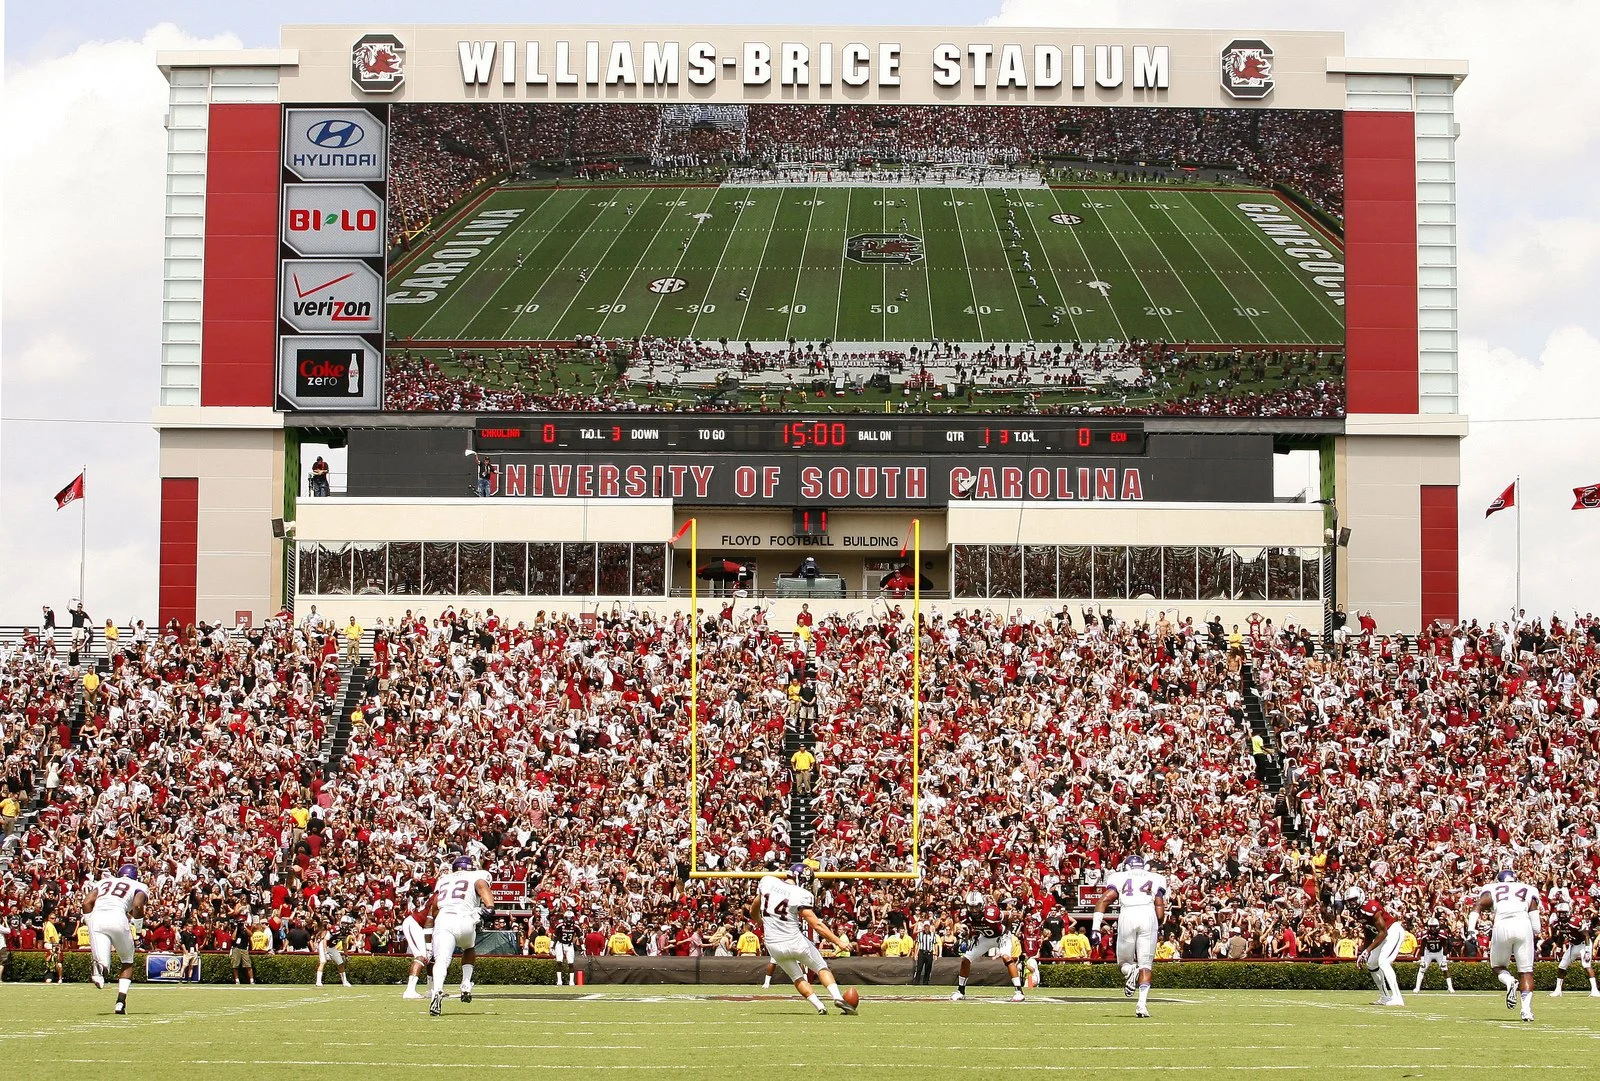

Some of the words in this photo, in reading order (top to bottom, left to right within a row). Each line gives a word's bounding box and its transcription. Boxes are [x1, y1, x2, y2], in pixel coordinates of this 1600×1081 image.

[457, 41, 902, 86] WILLIAMS-BRICE
[932, 43, 1171, 89] STADIUM
[293, 154, 377, 166] HYUNDAI
[1050, 214, 1082, 226] SEC
[386, 208, 526, 304] CAROLINA
[649, 277, 687, 294] SEC
[293, 296, 374, 321] verizon
[512, 303, 540, 313] 10
[596, 303, 627, 314] 20
[686, 303, 717, 314] 30
[777, 304, 807, 314] 40
[870, 304, 899, 314] 50
[963, 305, 992, 315] 40
[1054, 305, 1083, 316] 30
[1143, 306, 1174, 316] 20
[1232, 306, 1261, 317] 10
[299, 360, 345, 378] Coke
[307, 376, 338, 387] zero
[544, 424, 555, 443] 0
[611, 426, 621, 441] 3
[631, 429, 659, 440] DOWN
[698, 429, 711, 440] TO
[712, 429, 725, 441] GO
[783, 423, 846, 446] 15:00
[858, 431, 878, 441] BALL
[879, 431, 892, 441] ON
[946, 431, 965, 442] QTR
[984, 427, 991, 443] 1
[999, 429, 1009, 444] 3
[1078, 428, 1090, 447] 0
[1110, 432, 1128, 442] ECU
[482, 464, 715, 498] UNIVERSITY
[734, 465, 781, 499] OF
[801, 466, 928, 499] SOUTH
[949, 466, 1145, 500] CAROLINA
[803, 511, 827, 532] 11
[721, 535, 761, 546] FLOYD
[769, 536, 834, 547] FOOTBALL
[843, 536, 899, 547] BUILDING
[98, 881, 131, 899] 38
[439, 879, 469, 902] 52
[1121, 878, 1154, 897] 44
[1495, 884, 1529, 903] 24
[763, 892, 790, 922] 14
[562, 932, 573, 942] 23
